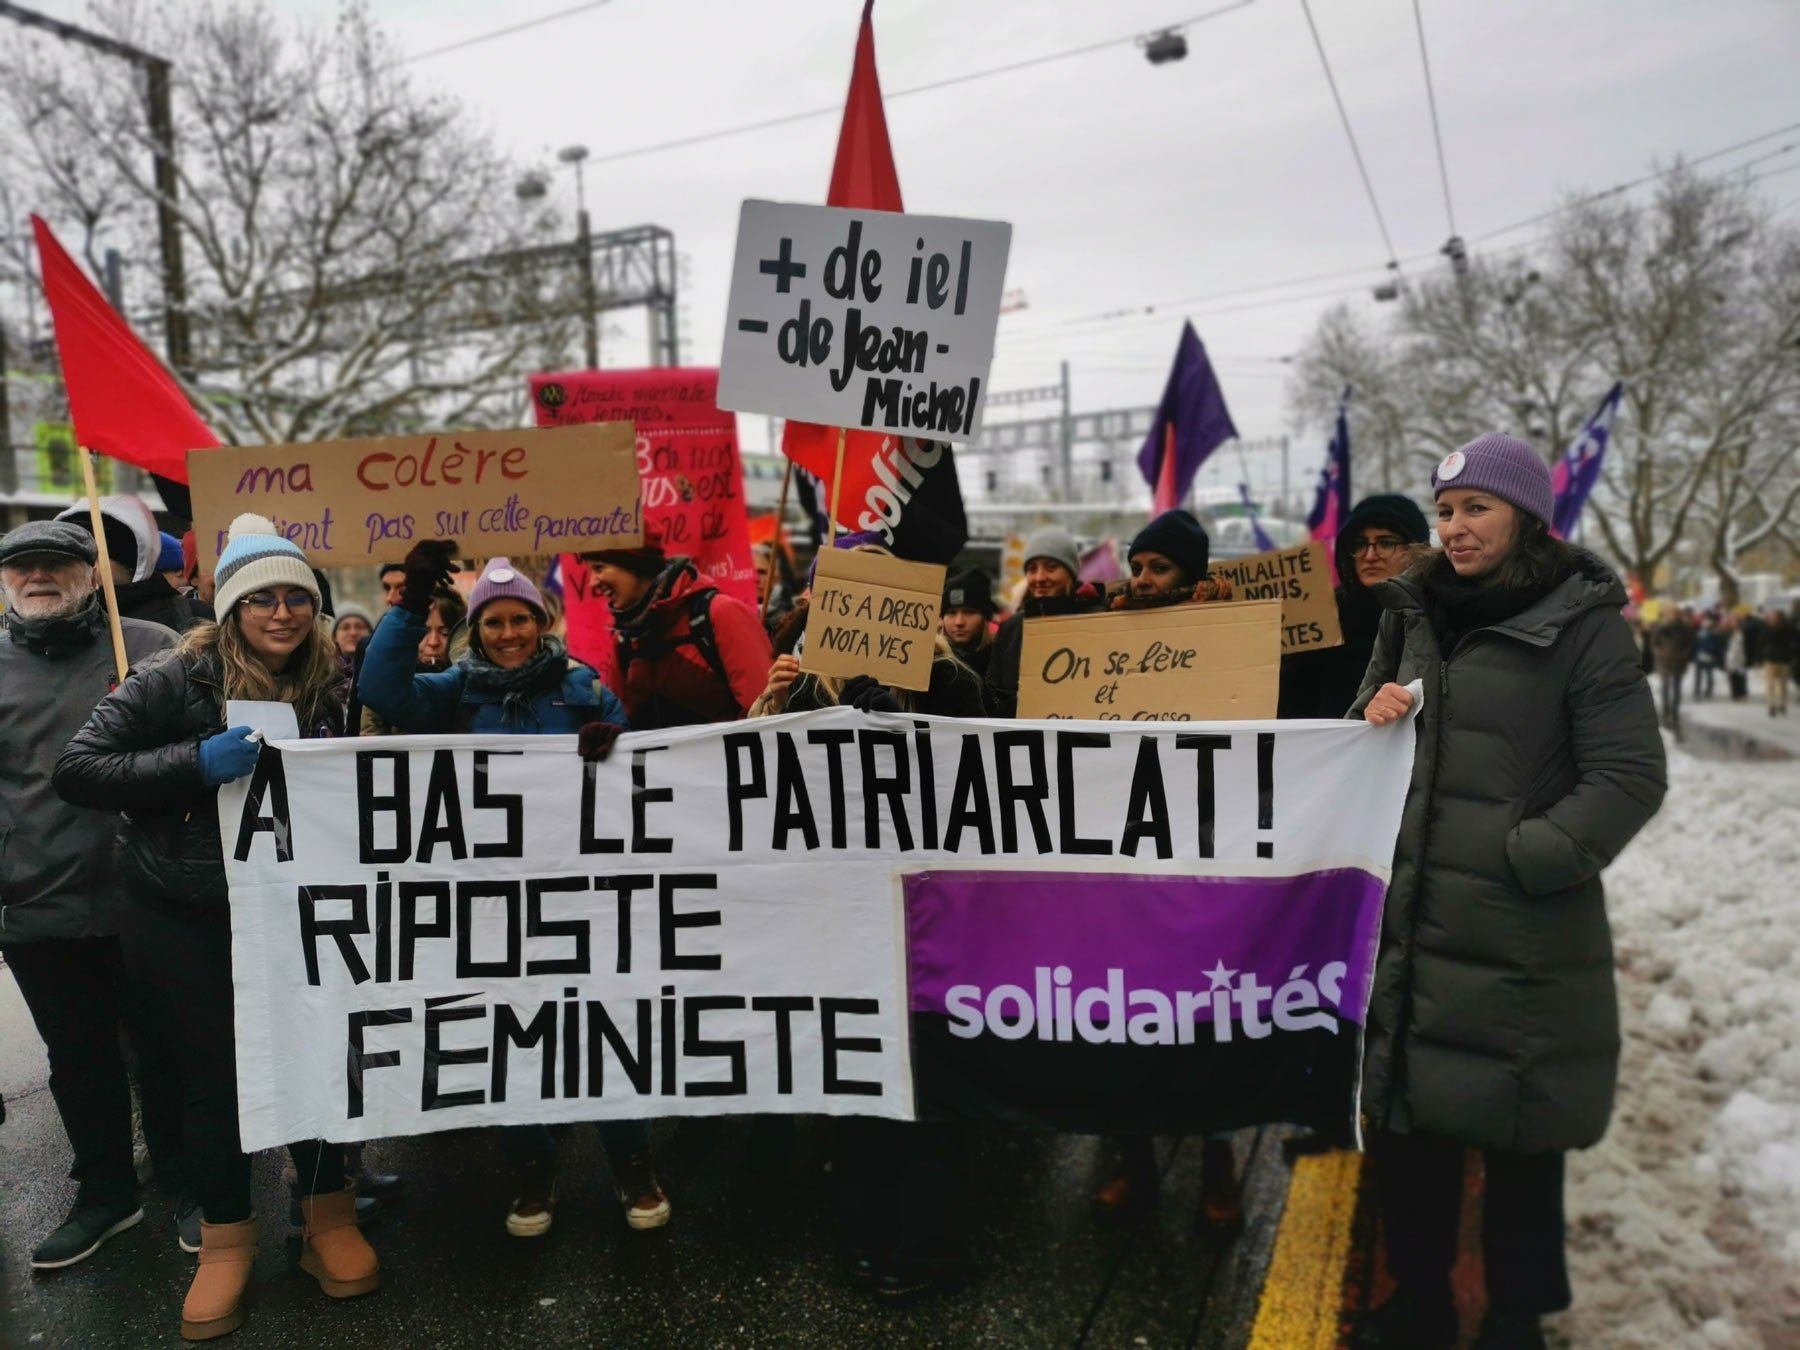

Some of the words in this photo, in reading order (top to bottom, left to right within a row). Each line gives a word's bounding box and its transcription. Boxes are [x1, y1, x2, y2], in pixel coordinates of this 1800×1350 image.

[823, 220, 882, 303] de
[906, 237, 972, 315] iel
[777, 299, 834, 367] de
[861, 377, 980, 435] Michel
[236, 463, 314, 494] ma
[366, 513, 416, 554] pas
[435, 510, 470, 537] sur
[479, 493, 530, 533] cette
[534, 498, 641, 551] pancarte!
[821, 589, 852, 617] IT'S
[855, 595, 871, 620] A
[878, 597, 934, 631] DRESS
[1281, 622, 1324, 647] TES
[820, 625, 860, 652] NOT
[855, 632, 869, 659] A
[878, 633, 913, 665] YES
[1042, 647, 1091, 685] On
[1104, 651, 1130, 676] se
[1136, 641, 1197, 673] lève
[1094, 680, 1119, 704] et
[356, 749, 523, 864] BAS
[580, 745, 674, 855] LE
[298, 871, 722, 986] RIPOSTE
[944, 958, 1349, 1046] solidarités
[347, 985, 883, 1119] FÉMINISTE
